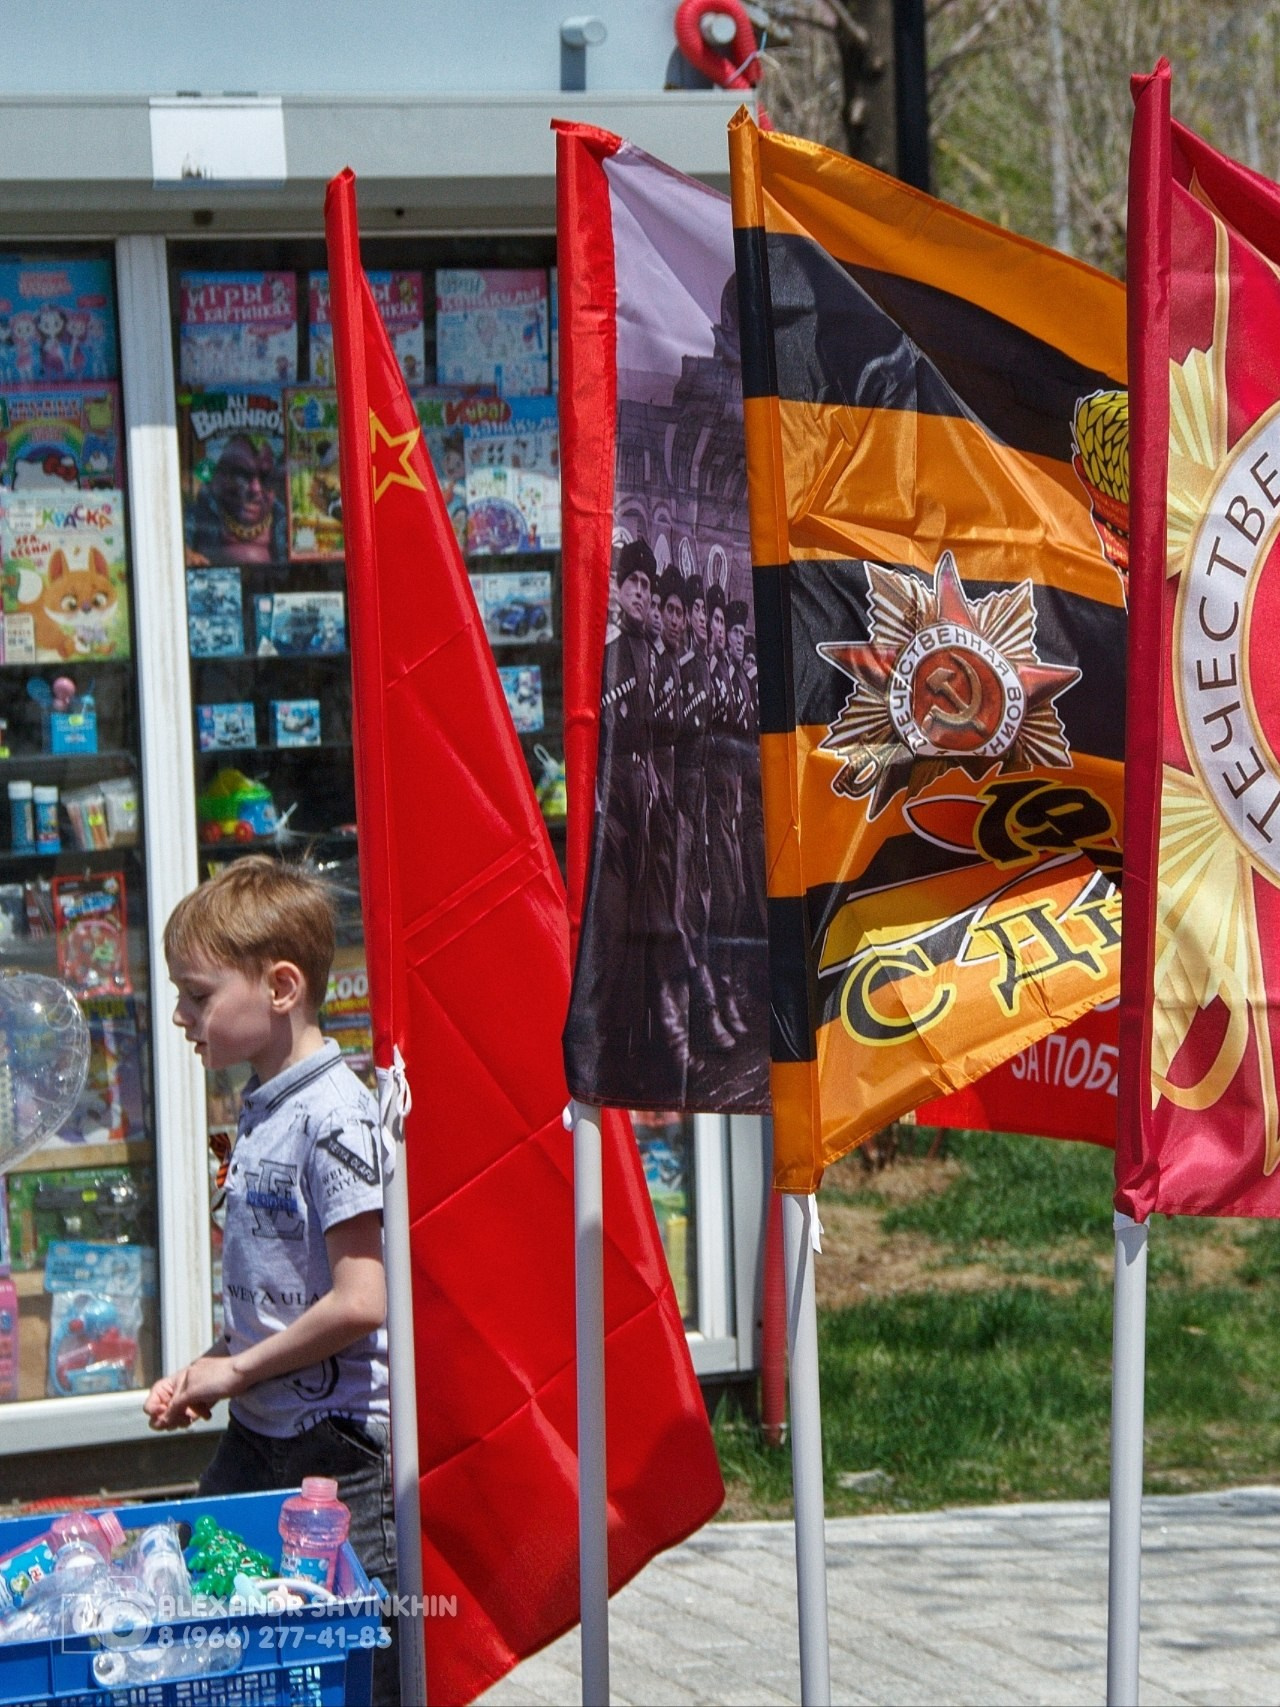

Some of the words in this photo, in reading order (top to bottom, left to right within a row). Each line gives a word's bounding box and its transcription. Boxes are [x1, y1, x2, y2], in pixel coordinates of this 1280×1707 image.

[188, 284, 263, 323] ИГРЫ
[840, 943, 957, 1047] С
[1044, 1034, 1120, 1098] ПОБ
